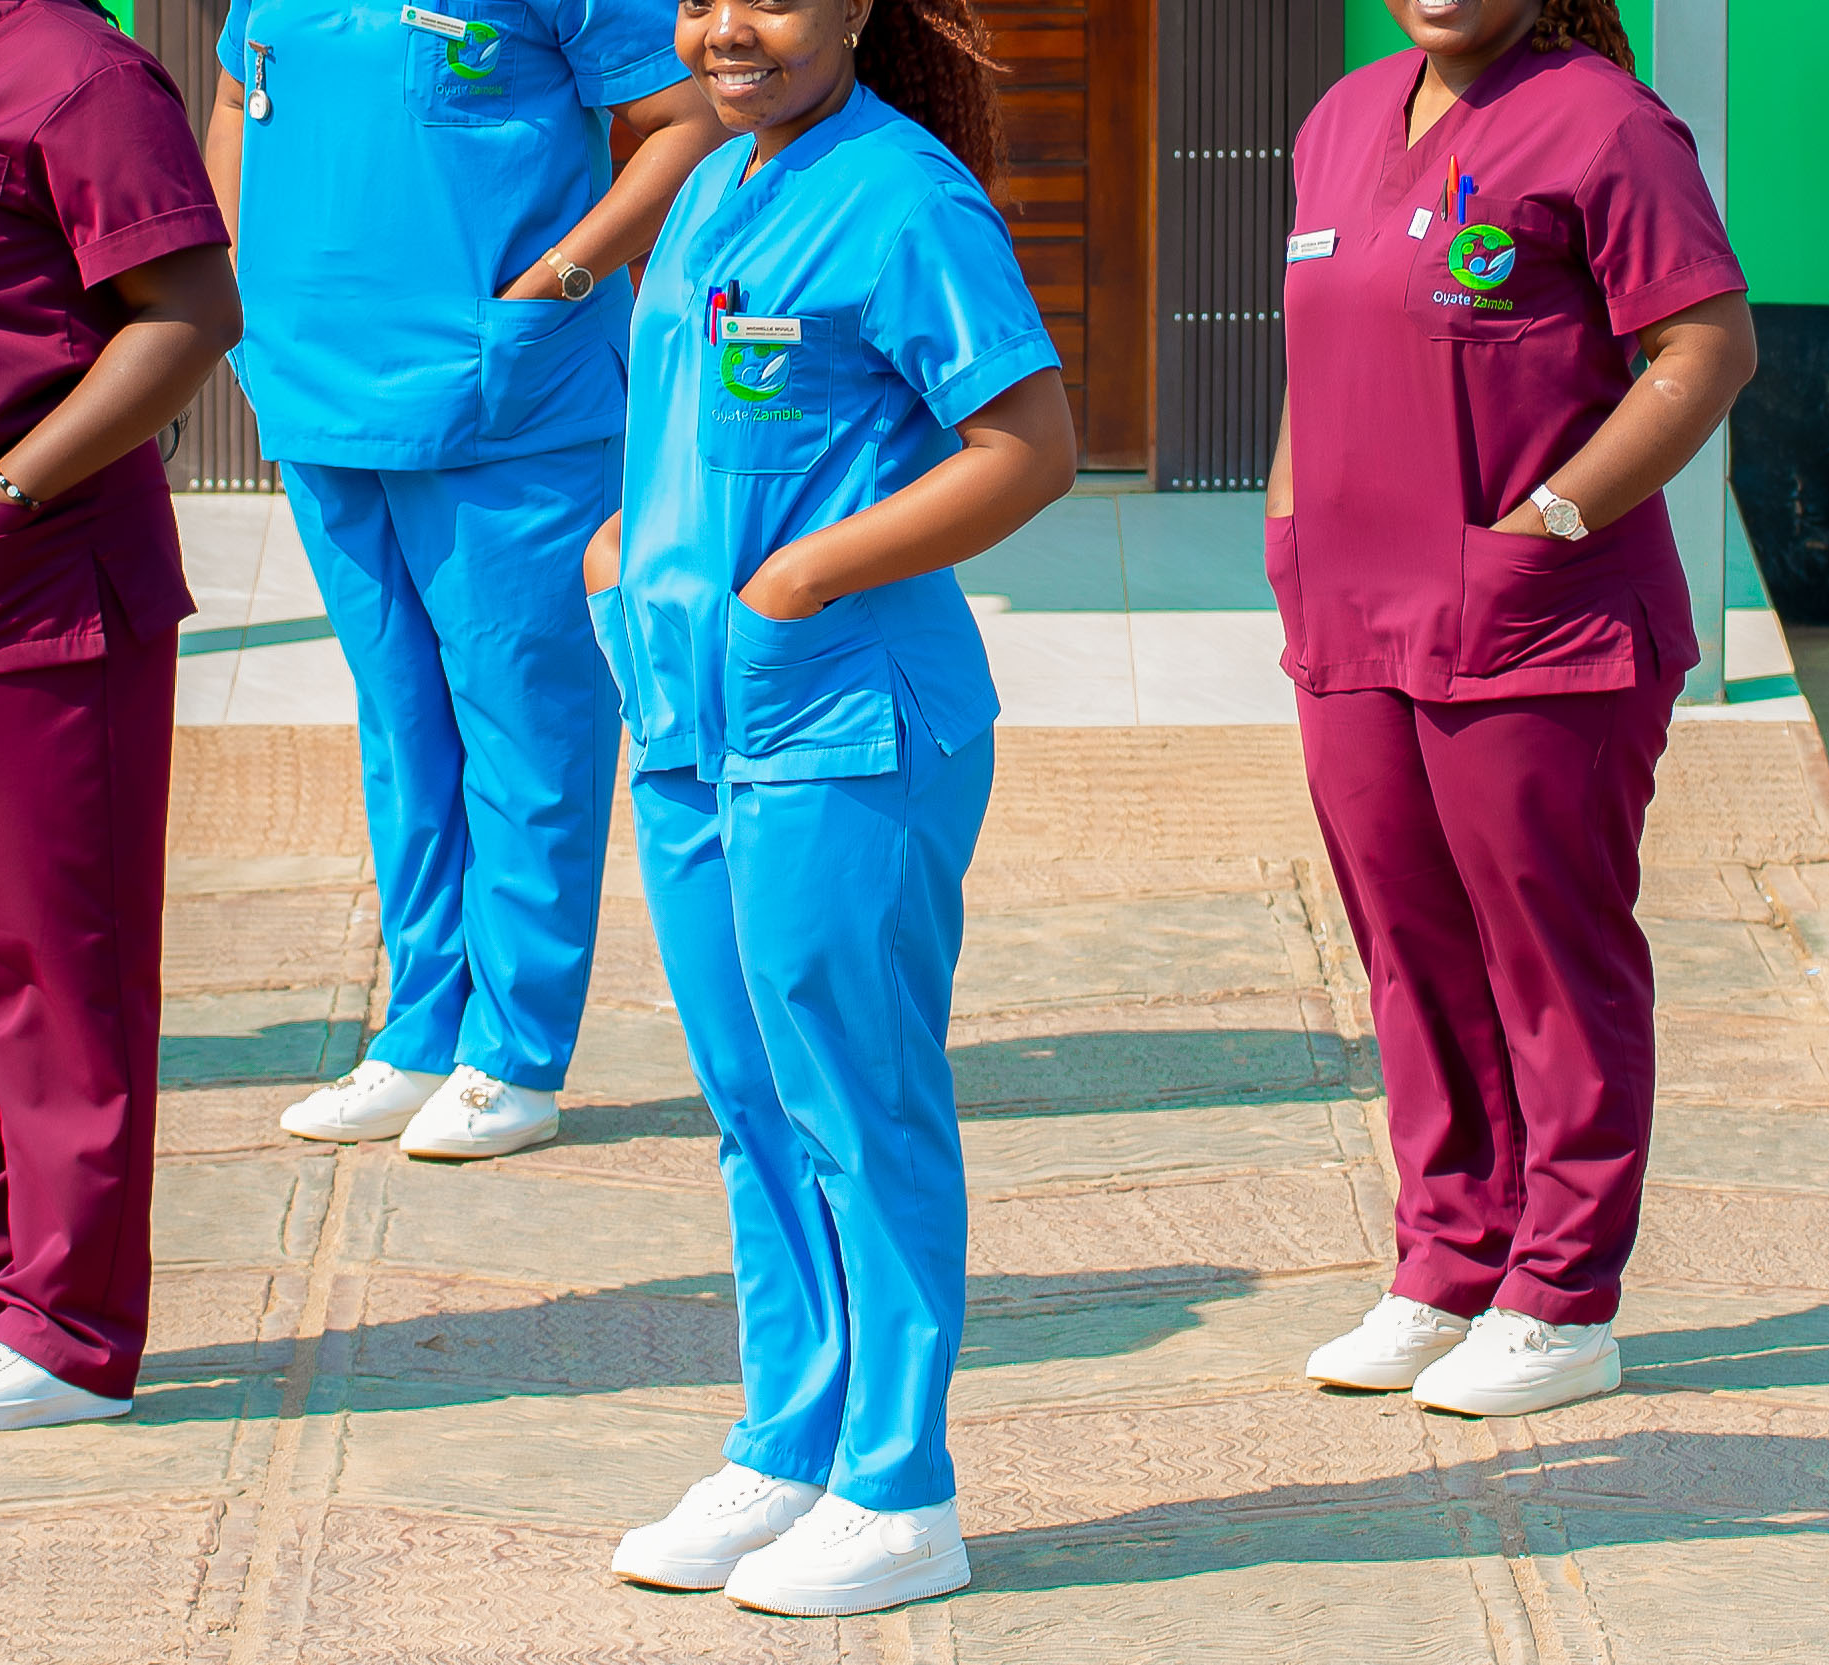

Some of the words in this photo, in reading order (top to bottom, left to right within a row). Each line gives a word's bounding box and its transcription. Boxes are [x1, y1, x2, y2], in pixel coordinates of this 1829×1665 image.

[1432, 291, 1471, 306] Oyate
[1472, 295, 1514, 311] Zambia
[711, 409, 749, 425] Oyate
[752, 407, 803, 422] Zambia
